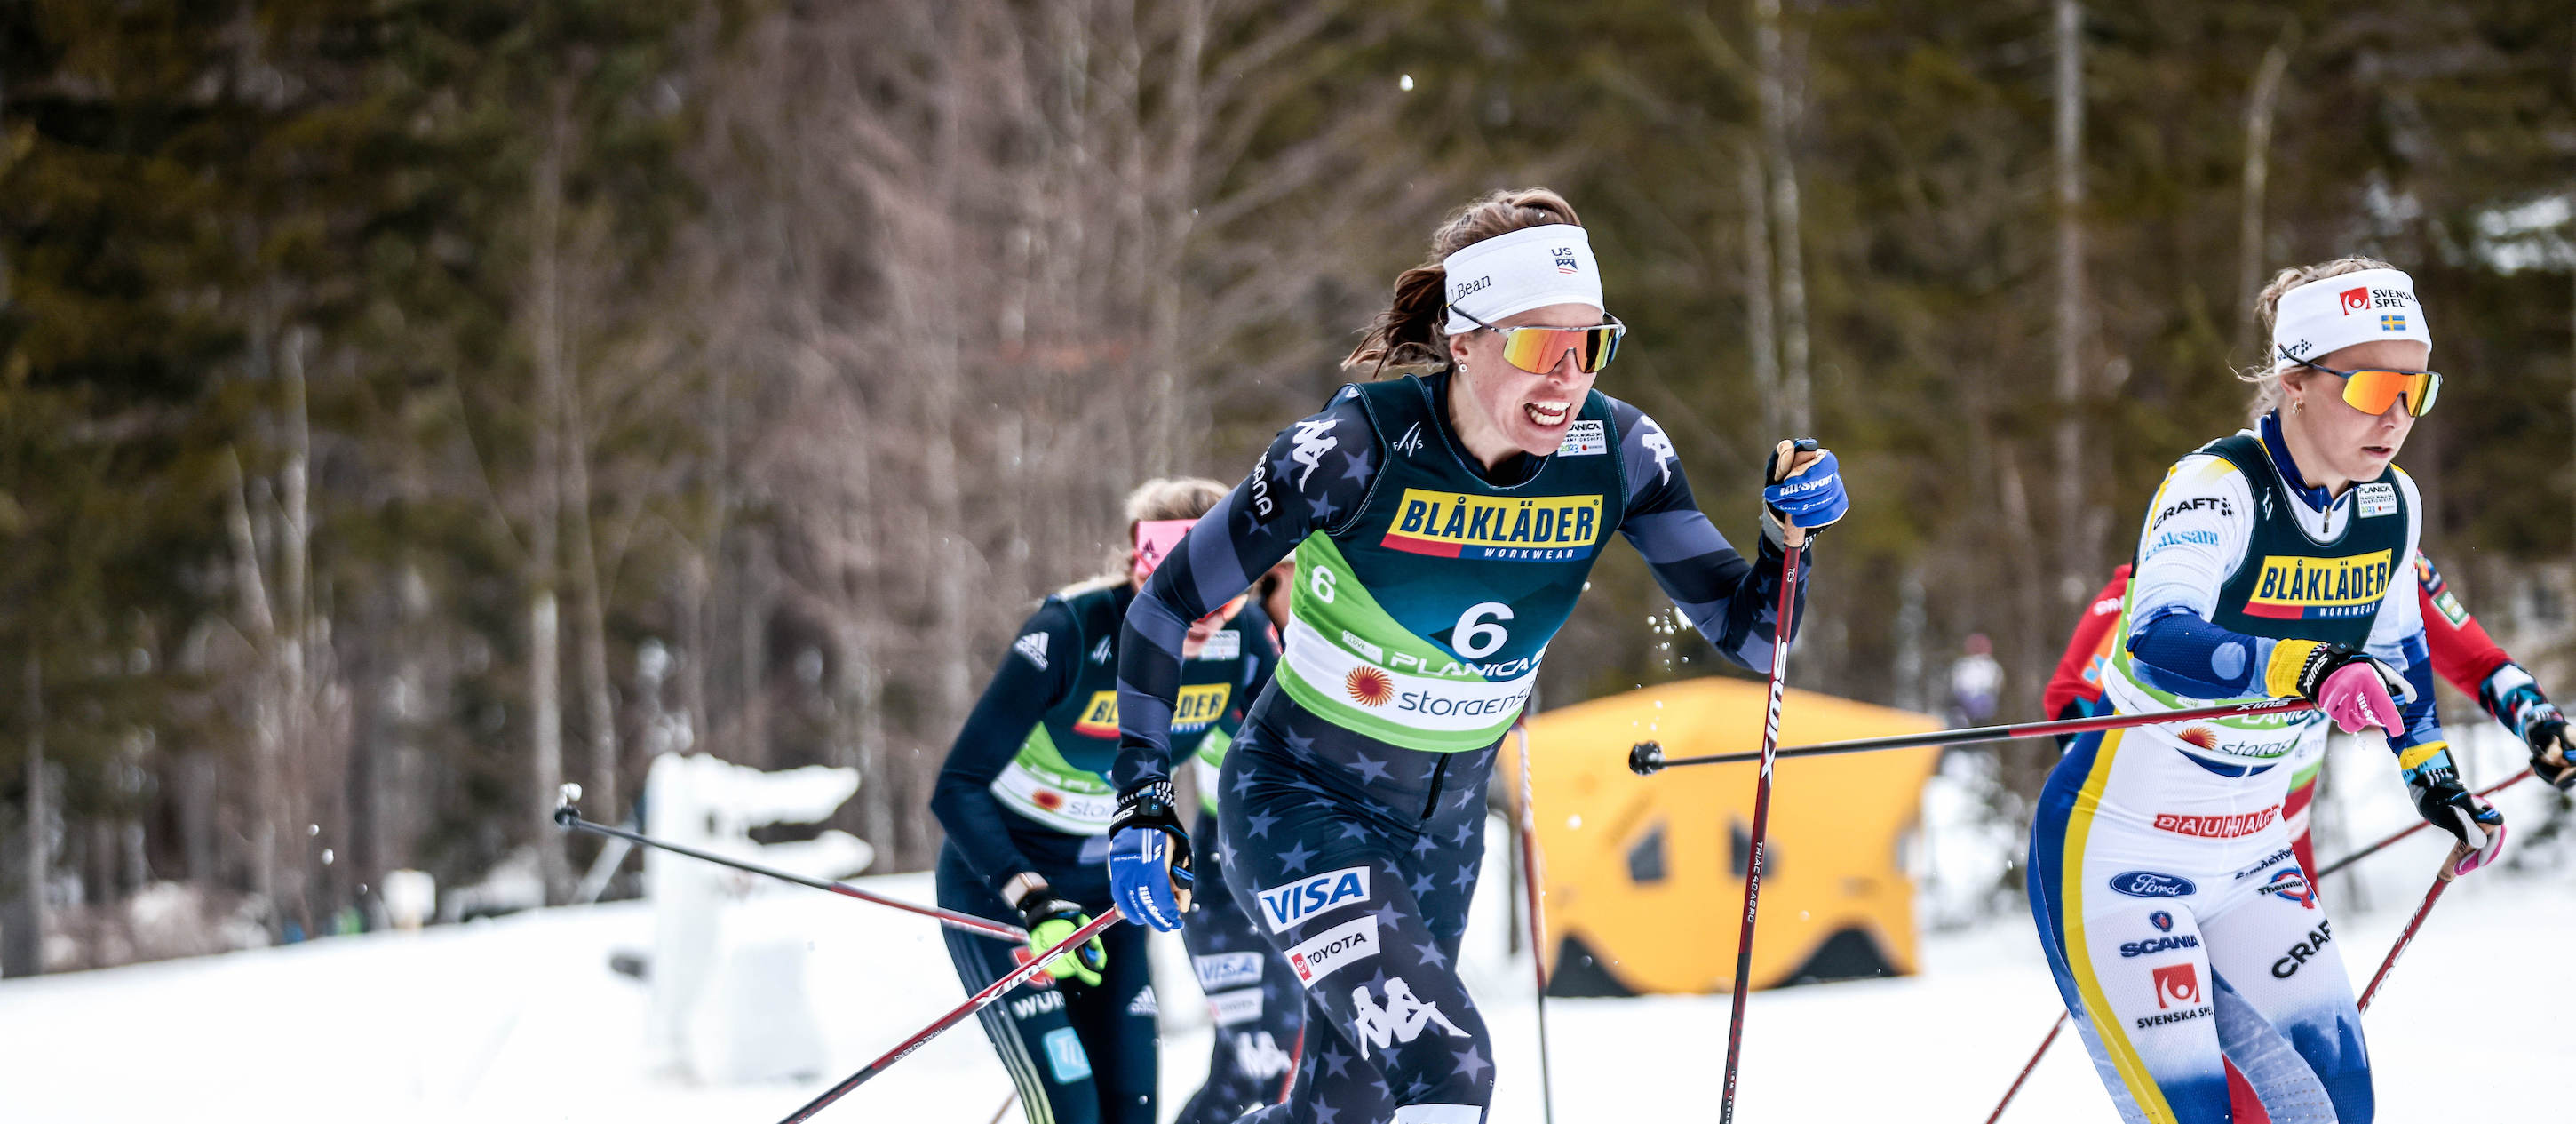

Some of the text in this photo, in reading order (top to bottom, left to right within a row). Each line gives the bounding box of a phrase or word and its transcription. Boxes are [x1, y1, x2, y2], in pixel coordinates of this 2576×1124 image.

[1551, 247, 1572, 256] US
[2375, 299, 2406, 308] SPEL
[1253, 450, 1273, 516] SANA
[1400, 496, 1595, 543] BLÅKLÄDER
[2153, 498, 2220, 530] CRAFT
[1484, 547, 1574, 560] WORKWEAR
[1311, 565, 1336, 603] 6
[2259, 559, 2388, 601] BLÅKLÄDER
[2319, 602, 2376, 617] WORKWEAR
[1451, 602, 1515, 658] 6
[1390, 651, 1530, 677] PLANICA
[2303, 653, 2328, 694] SWIX
[1761, 634, 1789, 787] SWIX
[1110, 804, 1137, 825] SWI
[1753, 841, 1763, 873] TRIAC
[1261, 872, 1364, 924] VISA
[2131, 873, 2182, 897] Ford
[2258, 880, 2303, 896] Thermia
[1747, 891, 1756, 923] AERO
[1308, 932, 1367, 967] TOYOTA
[2120, 935, 2200, 958] SCANIA
[2271, 918, 2332, 978] CRAF
[2137, 1008, 2198, 1029] SVENSKA
